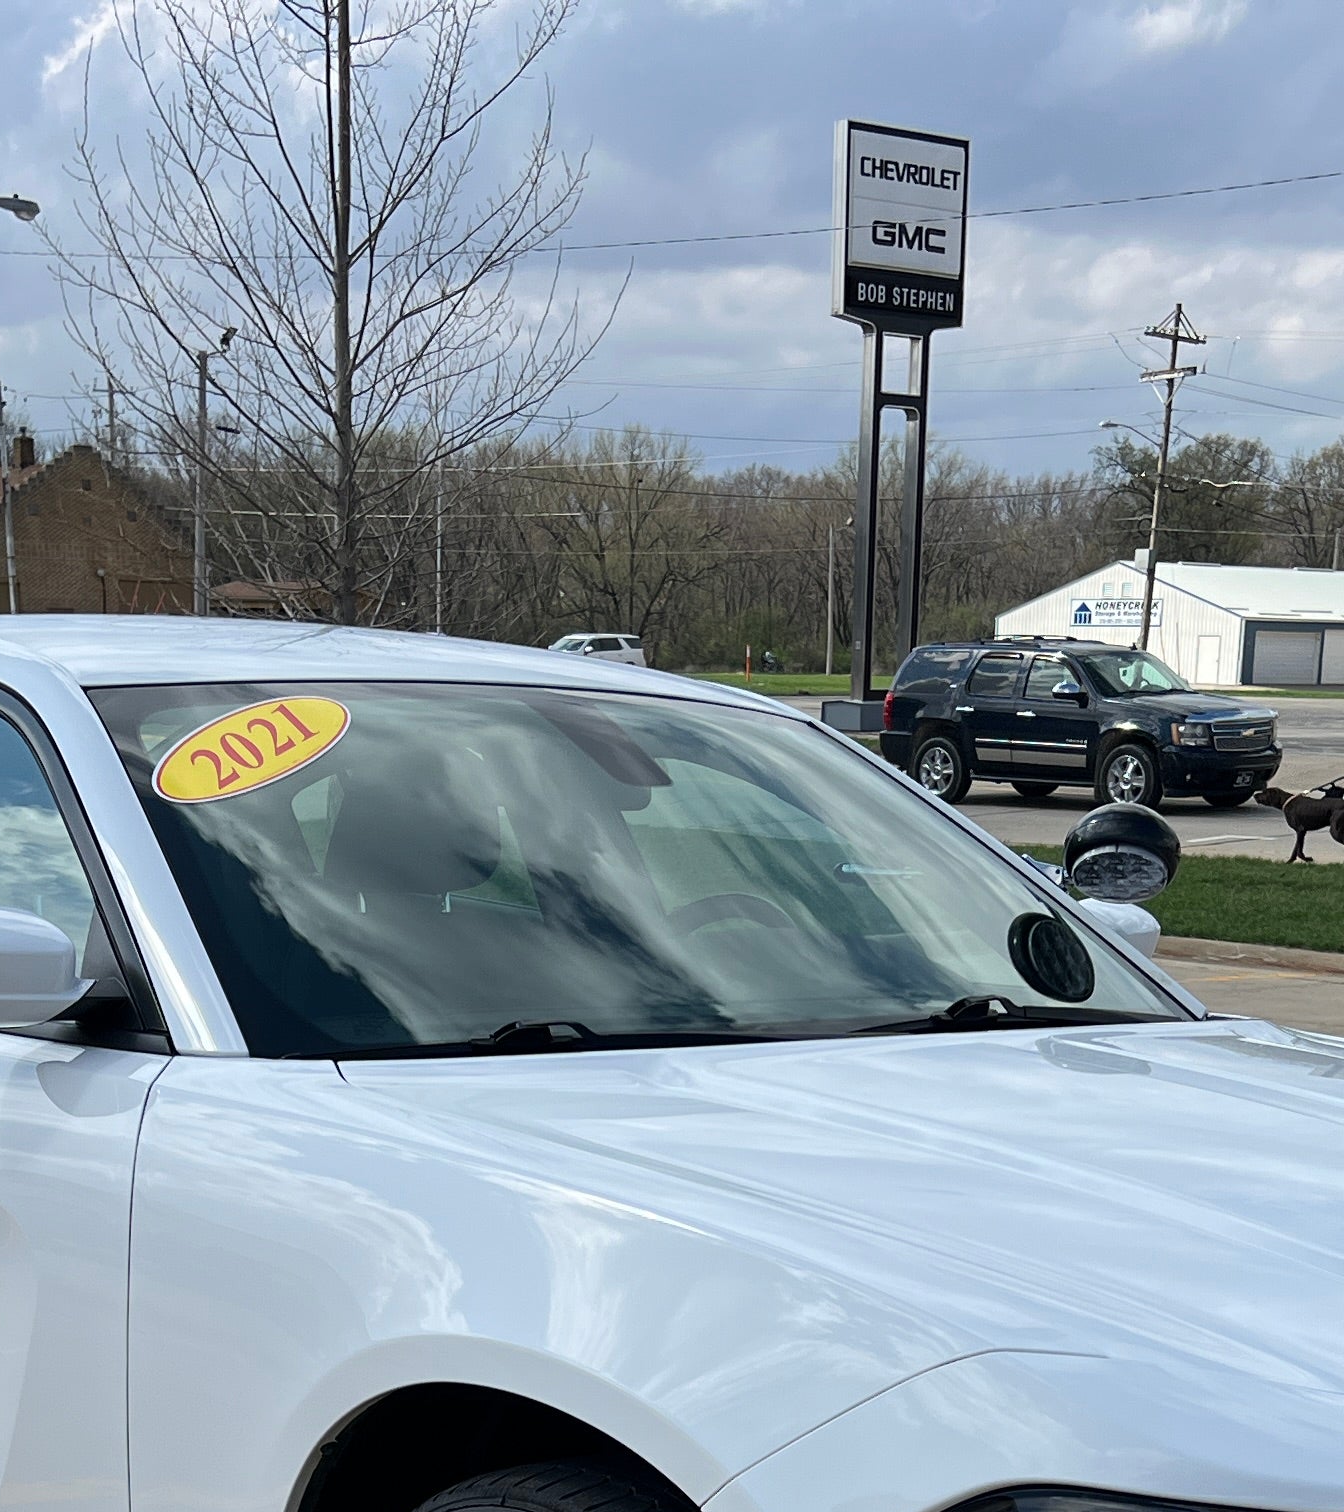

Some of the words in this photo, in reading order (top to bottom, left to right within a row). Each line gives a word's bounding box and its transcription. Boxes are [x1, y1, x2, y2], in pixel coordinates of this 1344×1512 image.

[860, 156, 961, 191] CHEVROLET
[872, 220, 946, 254] GMC
[858, 282, 886, 304] BOB
[892, 286, 954, 312] STEPHEN
[190, 703, 320, 790] 2021
